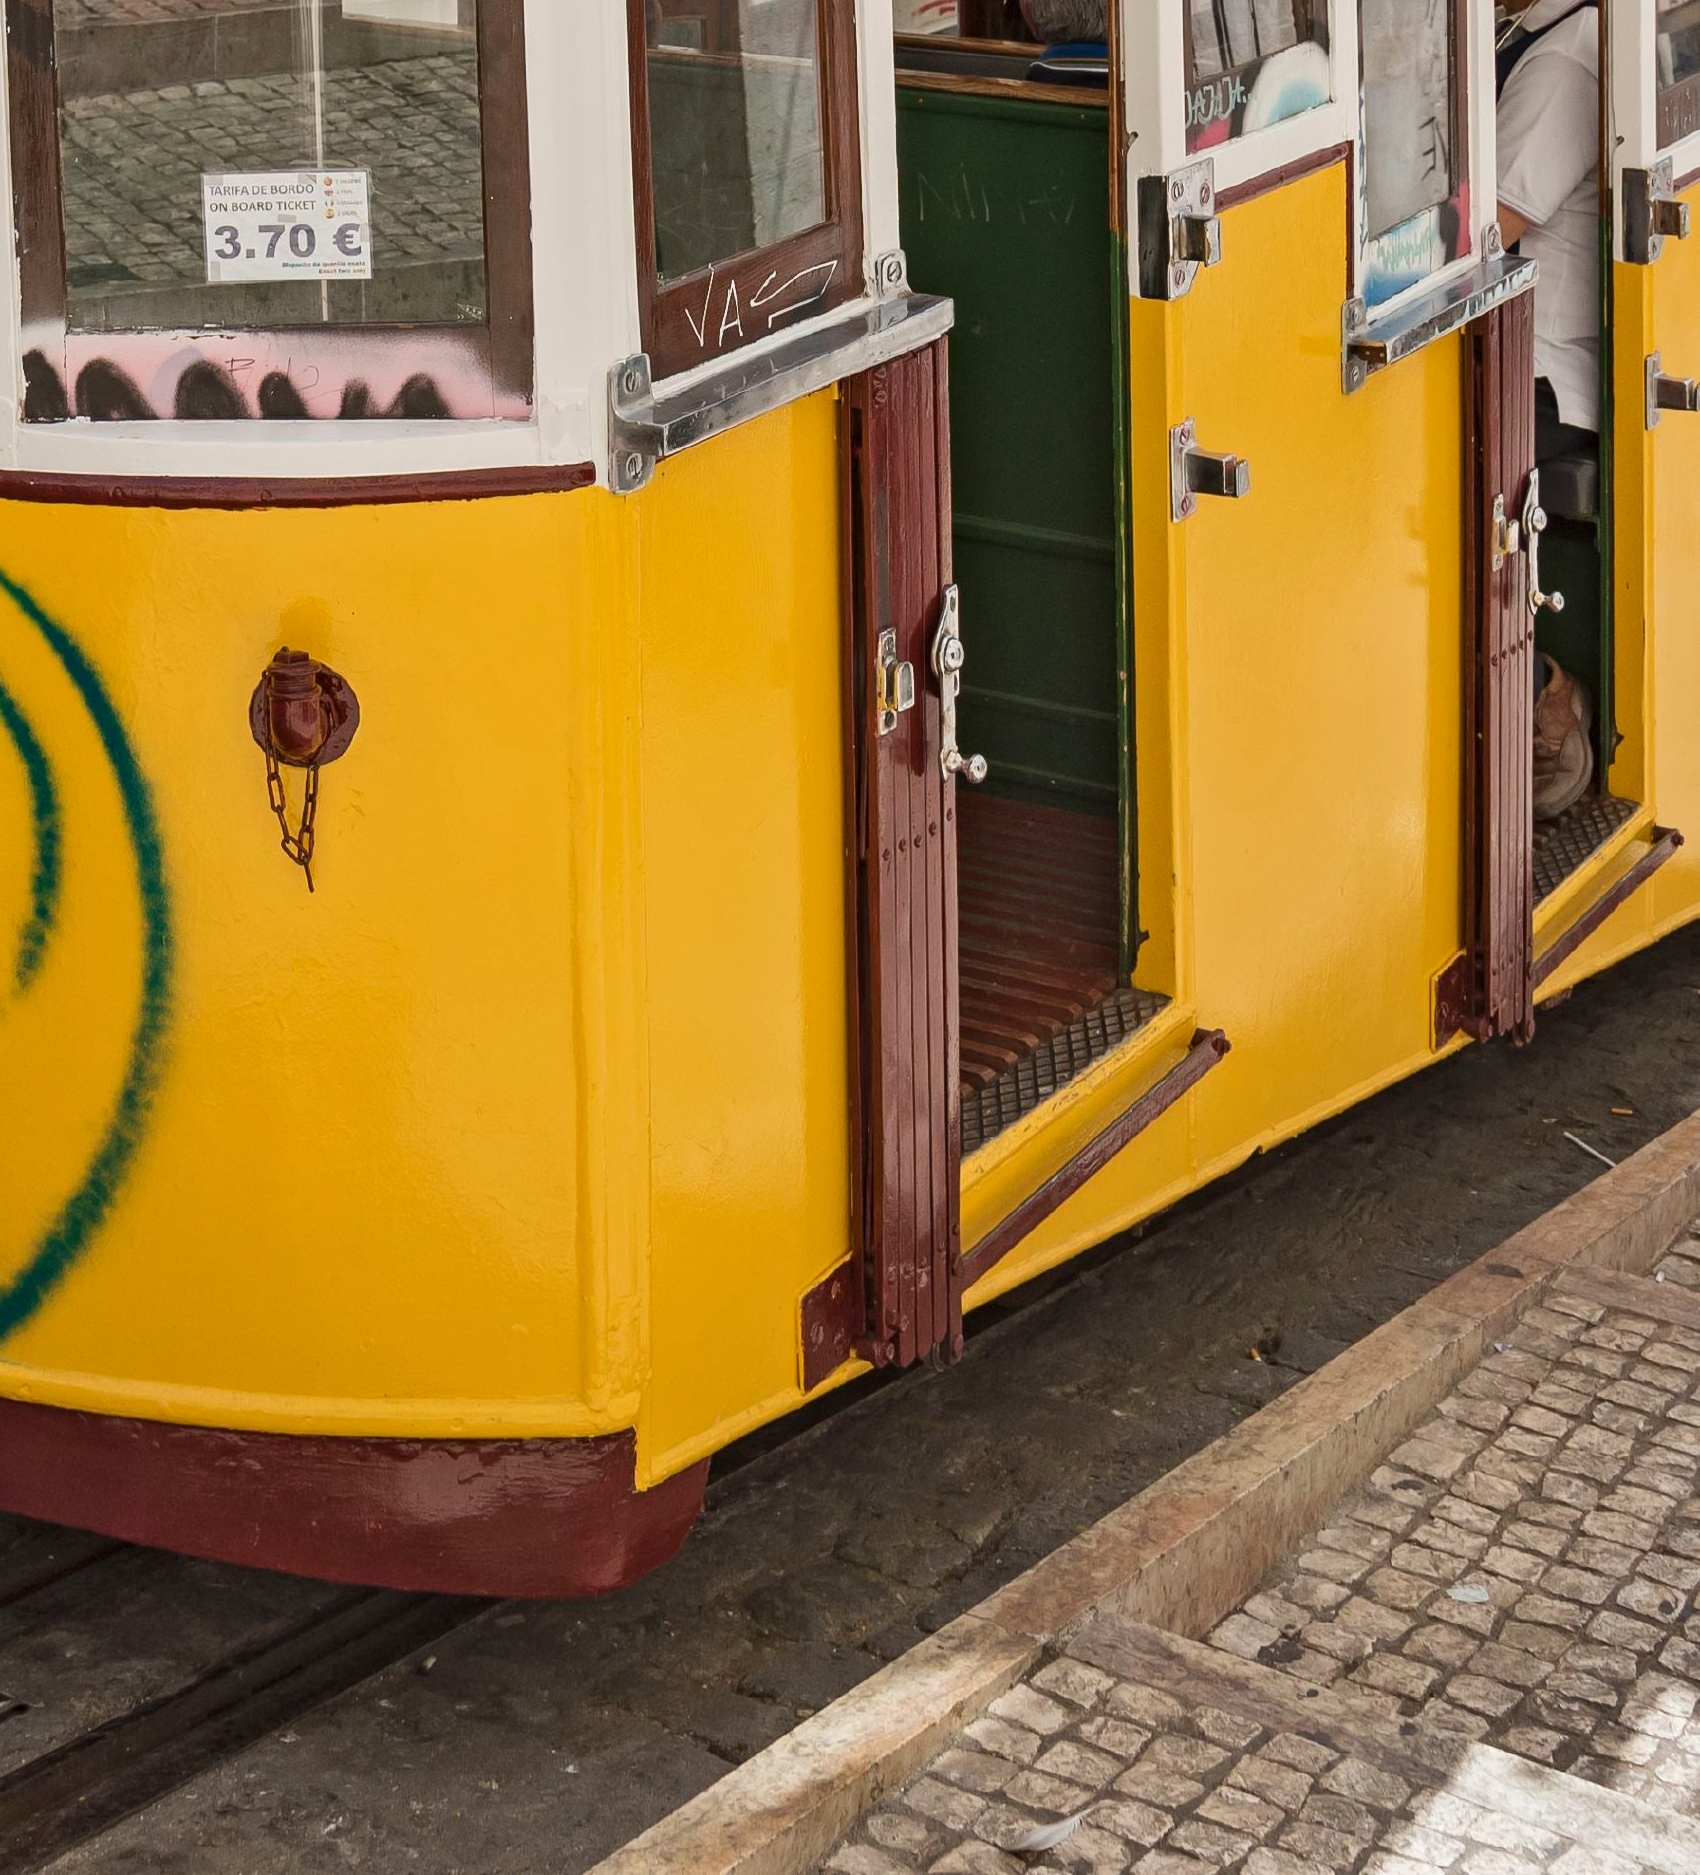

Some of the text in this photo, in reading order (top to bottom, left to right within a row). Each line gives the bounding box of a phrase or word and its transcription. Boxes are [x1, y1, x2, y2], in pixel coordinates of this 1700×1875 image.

[209, 184, 315, 197] TARIFA DE BORDO
[209, 200, 317, 213] ON BOARD TICKET
[214, 223, 362, 260] 3.70 €
